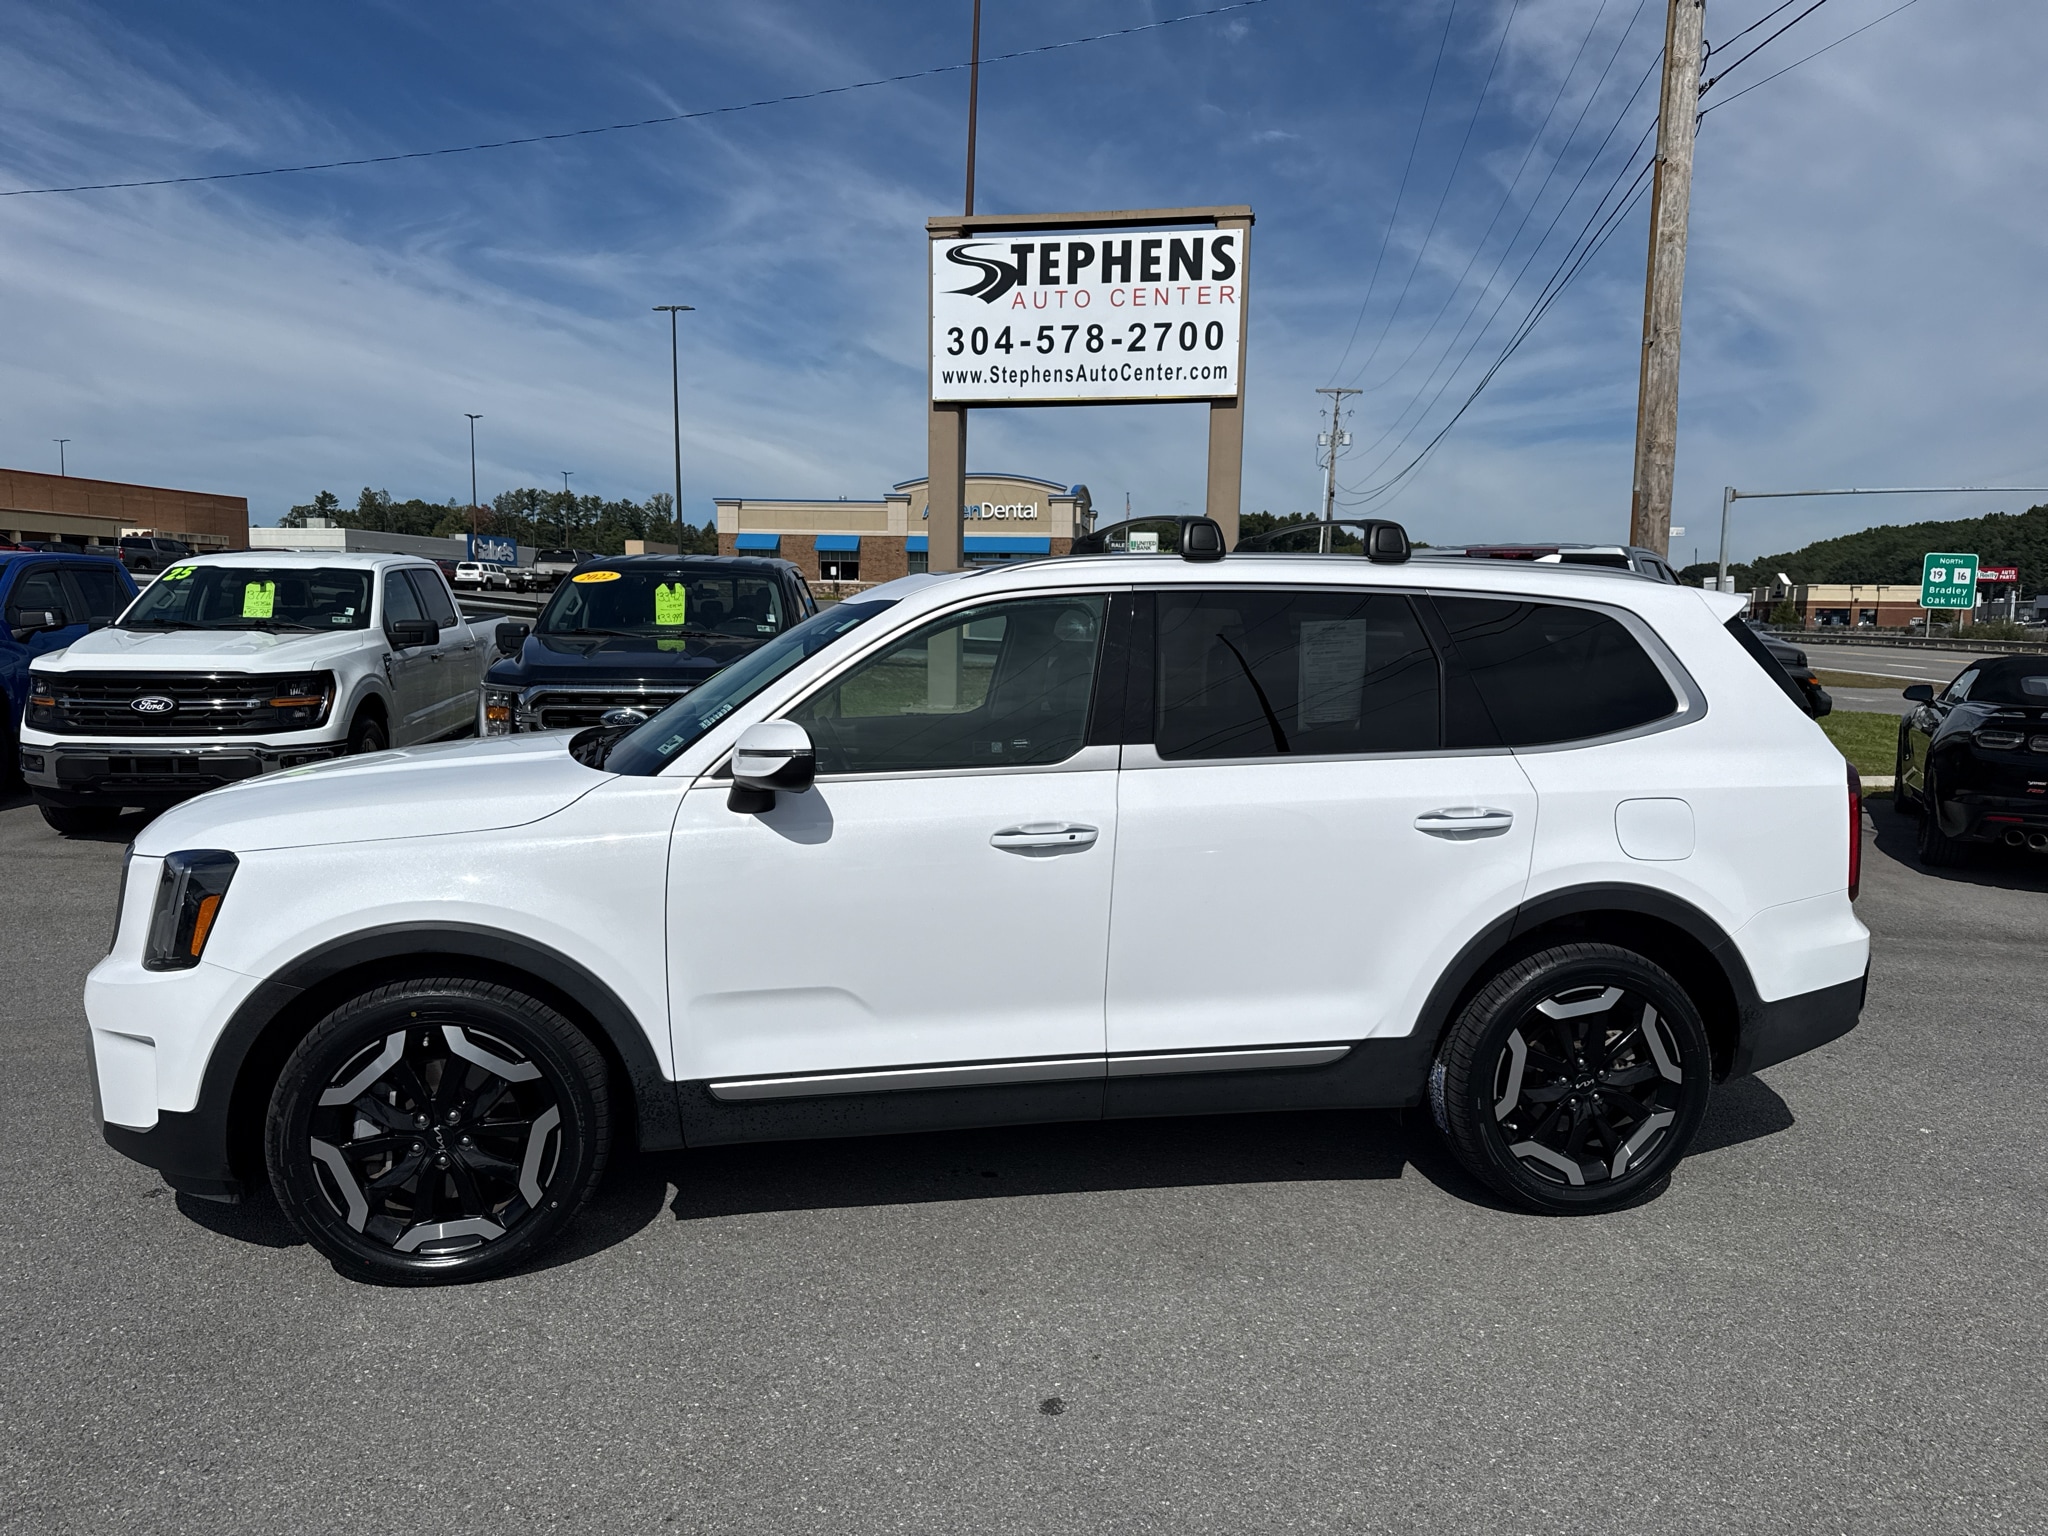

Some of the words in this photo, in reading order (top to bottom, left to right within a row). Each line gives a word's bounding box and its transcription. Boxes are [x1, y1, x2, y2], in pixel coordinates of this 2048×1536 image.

[939, 235, 1236, 304] STEPHENS
[1011, 290, 1091, 310] AUTO
[1110, 286, 1235, 307] CENTER
[946, 321, 1224, 356] 304-578-2700
[942, 362, 1228, 387] www.StephensAutoCenter.com
[162, 566, 198, 581] 25
[1933, 570, 1943, 580] 19
[1957, 571, 1967, 581] 16
[1929, 586, 1968, 596] Bradley
[1926, 596, 1946, 605] Oak
[1950, 597, 1968, 605] Hill
[139, 700, 165, 710] Ford
